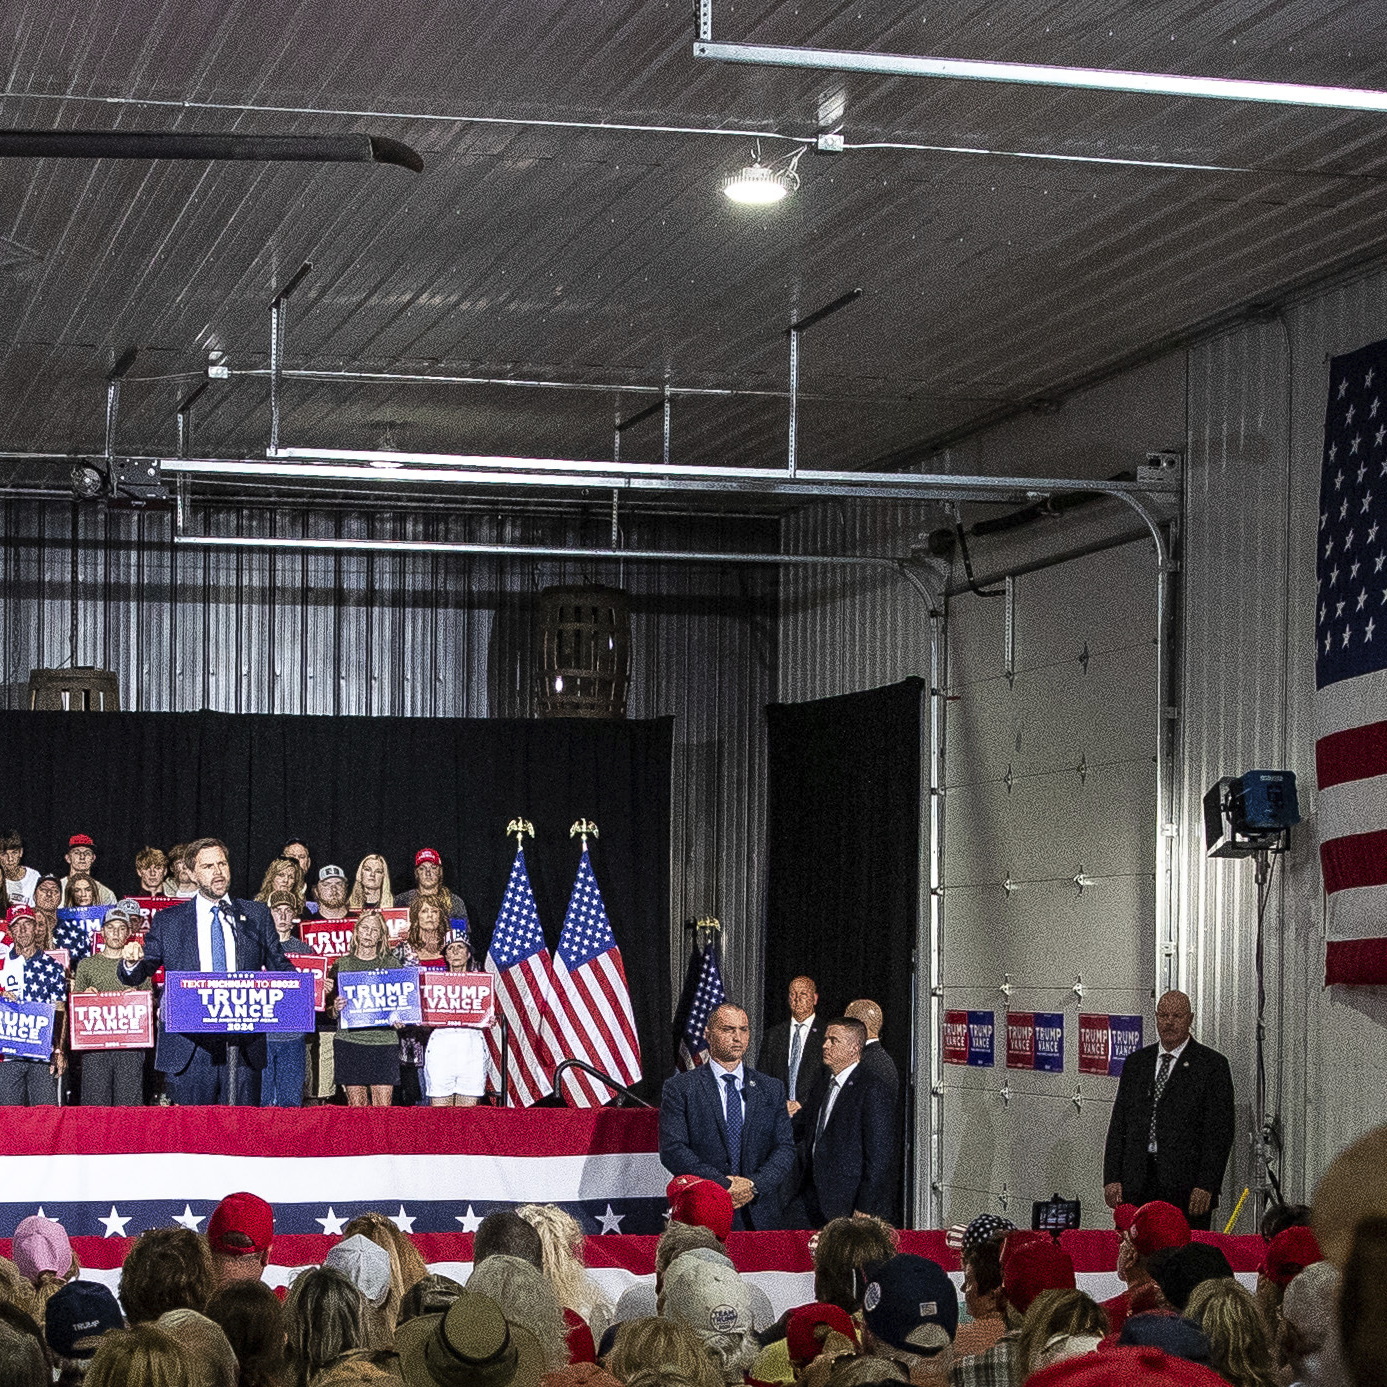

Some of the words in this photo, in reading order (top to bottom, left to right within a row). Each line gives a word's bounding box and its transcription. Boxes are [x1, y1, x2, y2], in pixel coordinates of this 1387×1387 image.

[182, 980, 207, 988] TEXT
[256, 980, 269, 988] TO
[343, 982, 415, 999] TRUMP
[197, 989, 284, 1005] TRUMP
[420, 985, 490, 999] TRUMP
[353, 995, 408, 1009] VANCE
[428, 998, 482, 1009] VANCE
[74, 1005, 147, 1020] TRUMP
[207, 1004, 274, 1018] VANCE
[83, 1018, 140, 1030] VANCE
[227, 1023, 254, 1031] 2024
[943, 1023, 968, 1036] TRUMP
[969, 1024, 993, 1037] TRUMP
[1008, 1025, 1033, 1038] TRUMP
[1035, 1027, 1062, 1040] TRUMP
[1080, 1028, 1108, 1042] TRUMP
[1112, 1030, 1140, 1045] TRUMP
[945, 1035, 965, 1047] VANCE
[972, 1036, 990, 1048] VANCE
[1010, 1038, 1030, 1051] VANCE
[1038, 1039, 1058, 1053] VANCE
[1083, 1042, 1106, 1055] VANCE
